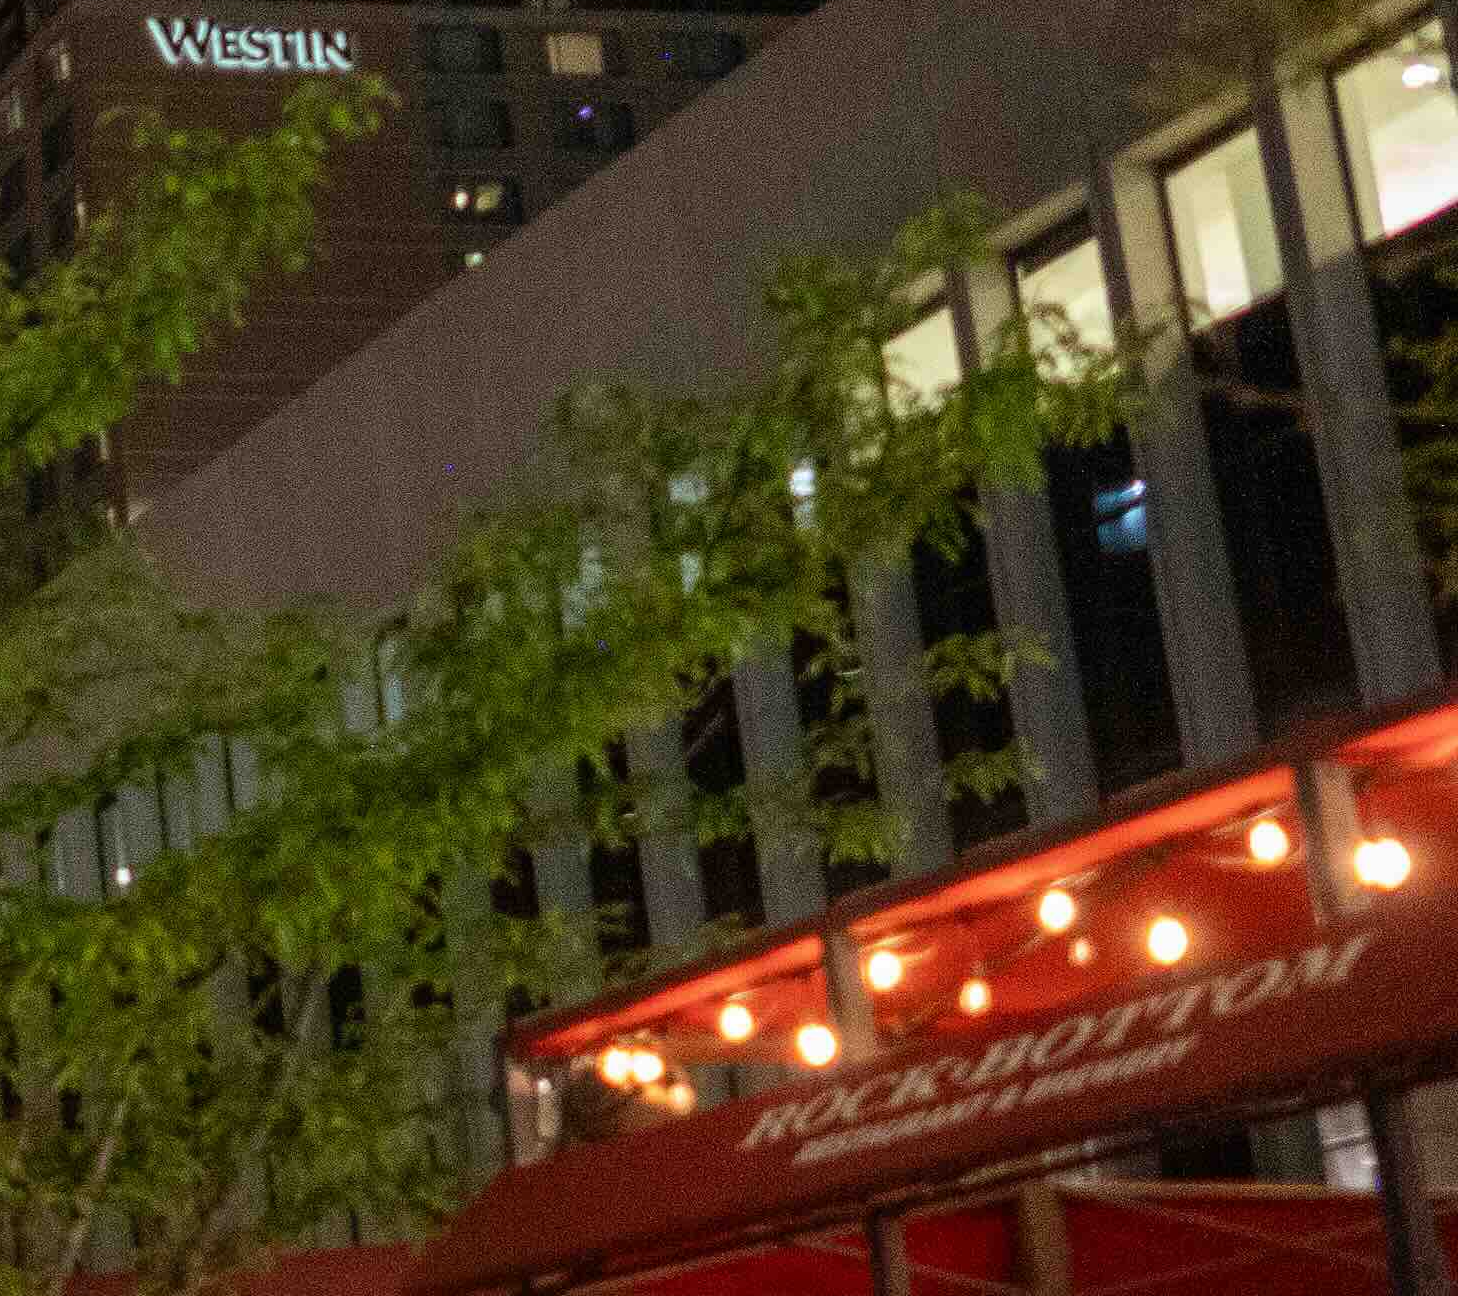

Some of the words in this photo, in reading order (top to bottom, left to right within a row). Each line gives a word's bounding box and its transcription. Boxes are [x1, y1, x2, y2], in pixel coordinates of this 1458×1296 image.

[145, 16, 354, 72] WESTIN
[741, 1054, 950, 1153] ROCK
[966, 932, 1374, 1086] BOTTOM
